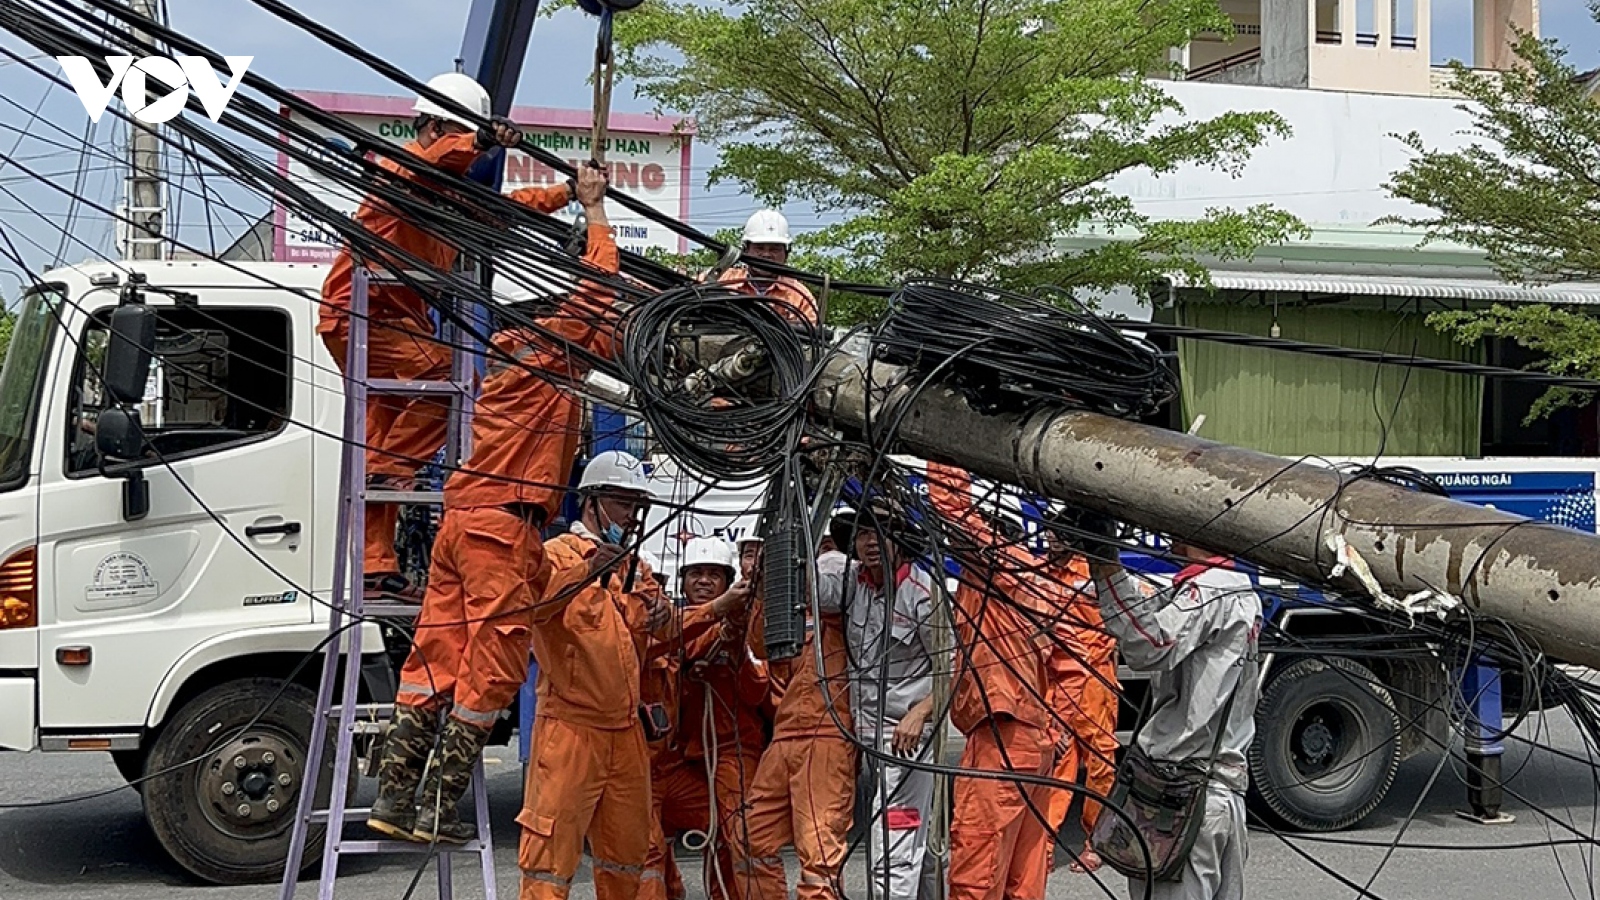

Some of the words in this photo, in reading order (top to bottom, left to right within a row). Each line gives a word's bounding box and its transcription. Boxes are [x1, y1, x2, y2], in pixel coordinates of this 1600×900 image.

[379, 119, 416, 139] CÔN
[579, 136, 611, 151] HU
[615, 139, 650, 157] HẠN
[619, 223, 648, 239] TRÌNH
[1435, 473, 1480, 486] QUẢNG
[1482, 473, 1512, 486] NGÃI
[713, 527, 746, 542] EV
